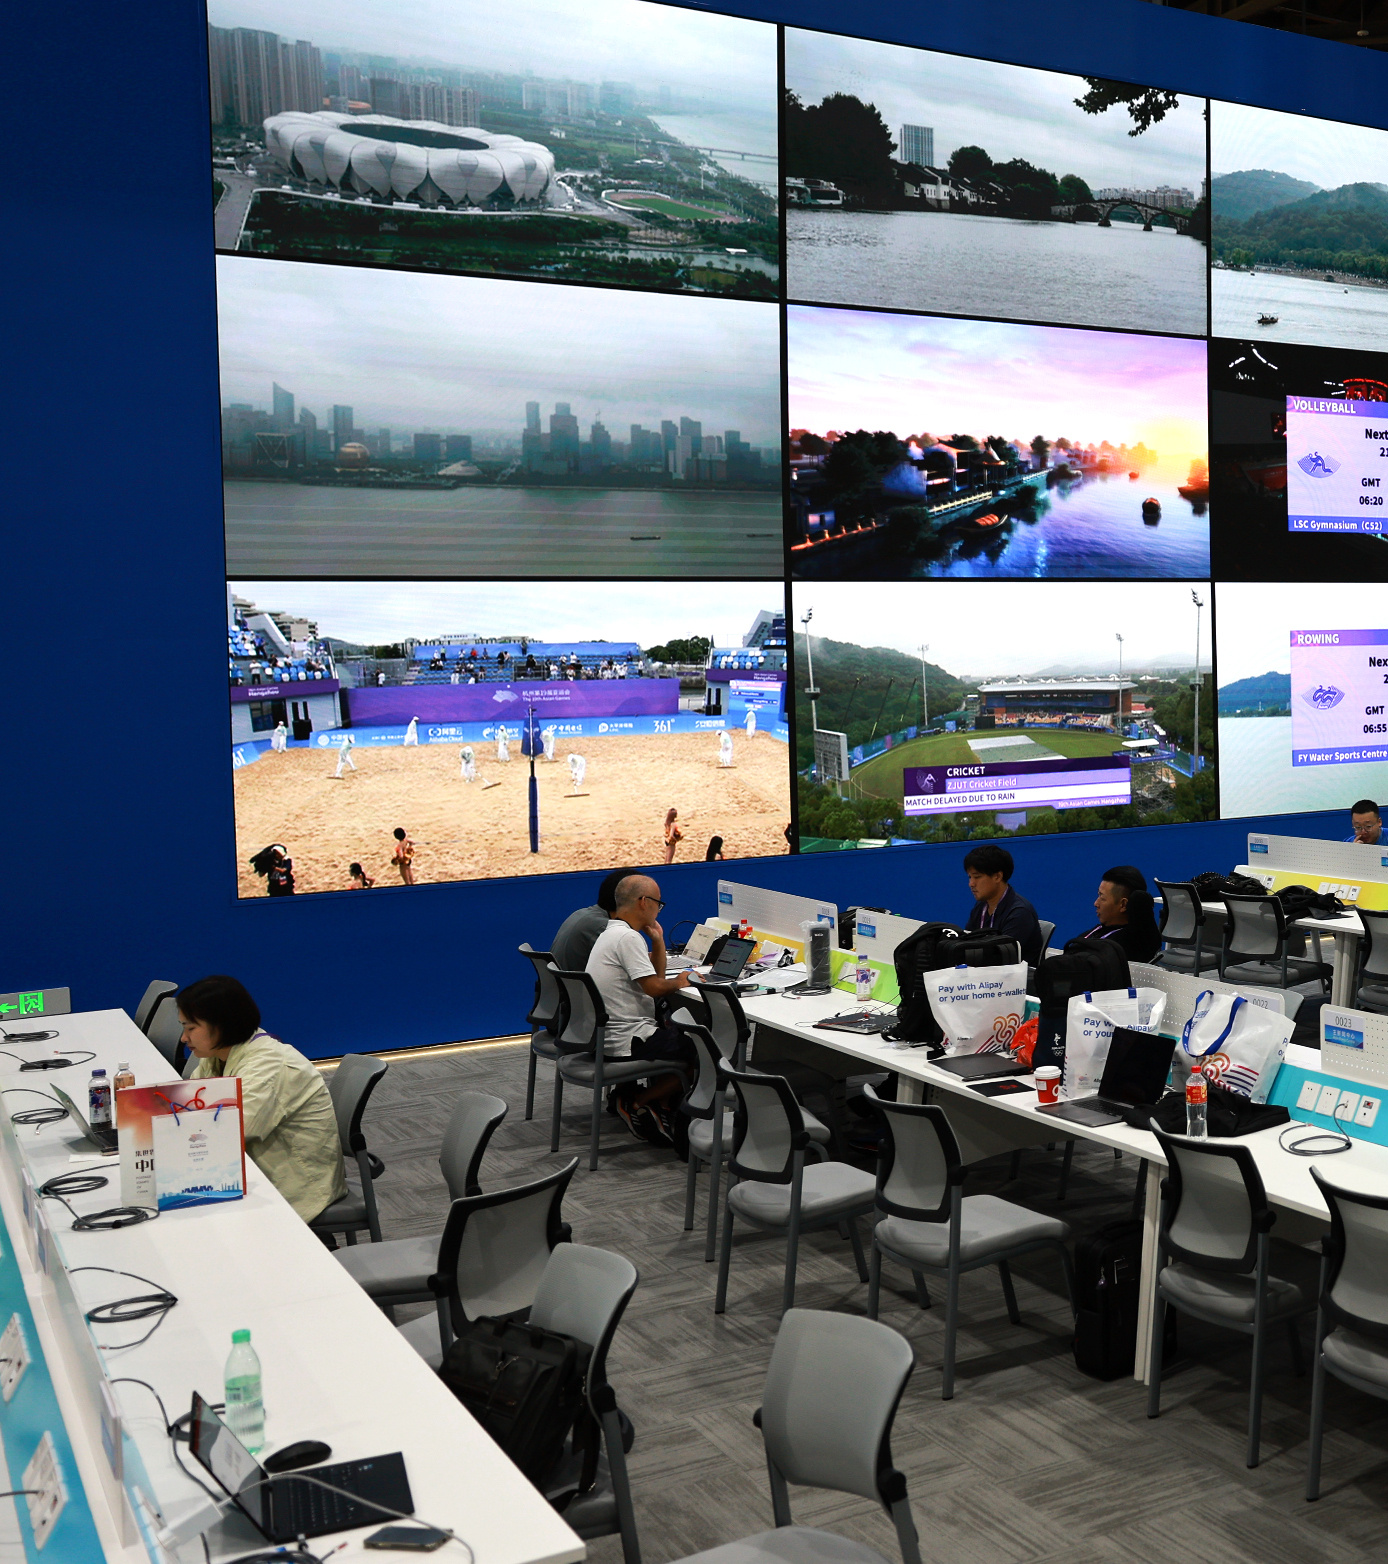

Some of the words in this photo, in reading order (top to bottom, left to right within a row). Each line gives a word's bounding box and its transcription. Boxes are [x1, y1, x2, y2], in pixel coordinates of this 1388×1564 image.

[1293, 399, 1356, 414] VOLLEYBALL
[1361, 477, 1381, 488] GMT
[1359, 495, 1384, 506] 06:20
[1293, 520, 1309, 529] LSC
[1310, 520, 1358, 531] Gymnasium
[1297, 633, 1340, 645] ROWING
[1365, 705, 1385, 716] GMT
[1363, 723, 1388, 734] 06:55
[1298, 753, 1309, 763] FY
[1309, 752, 1333, 762] Water
[1334, 750, 1361, 762] Sports
[1361, 748, 1388, 759] Centre
[946, 766, 986, 777] CRICKET
[947, 780, 968, 790] ZJUT
[969, 778, 996, 789] Cricket
[998, 777, 1017, 787] Field
[905, 798, 932, 807] MATCH
[934, 796, 968, 806] DELAYED
[969, 794, 984, 803] DUE
[986, 793, 996, 802] TO
[998, 792, 1015, 801] RAIN
[938, 985, 955, 993] Pay
[957, 983, 976, 991] with
[978, 981, 1004, 990] Alipay
[950, 994, 970, 1003] your
[972, 992, 996, 1000] home
[1083, 1017, 1101, 1028] Pay
[1335, 1016, 1352, 1028] 0023
